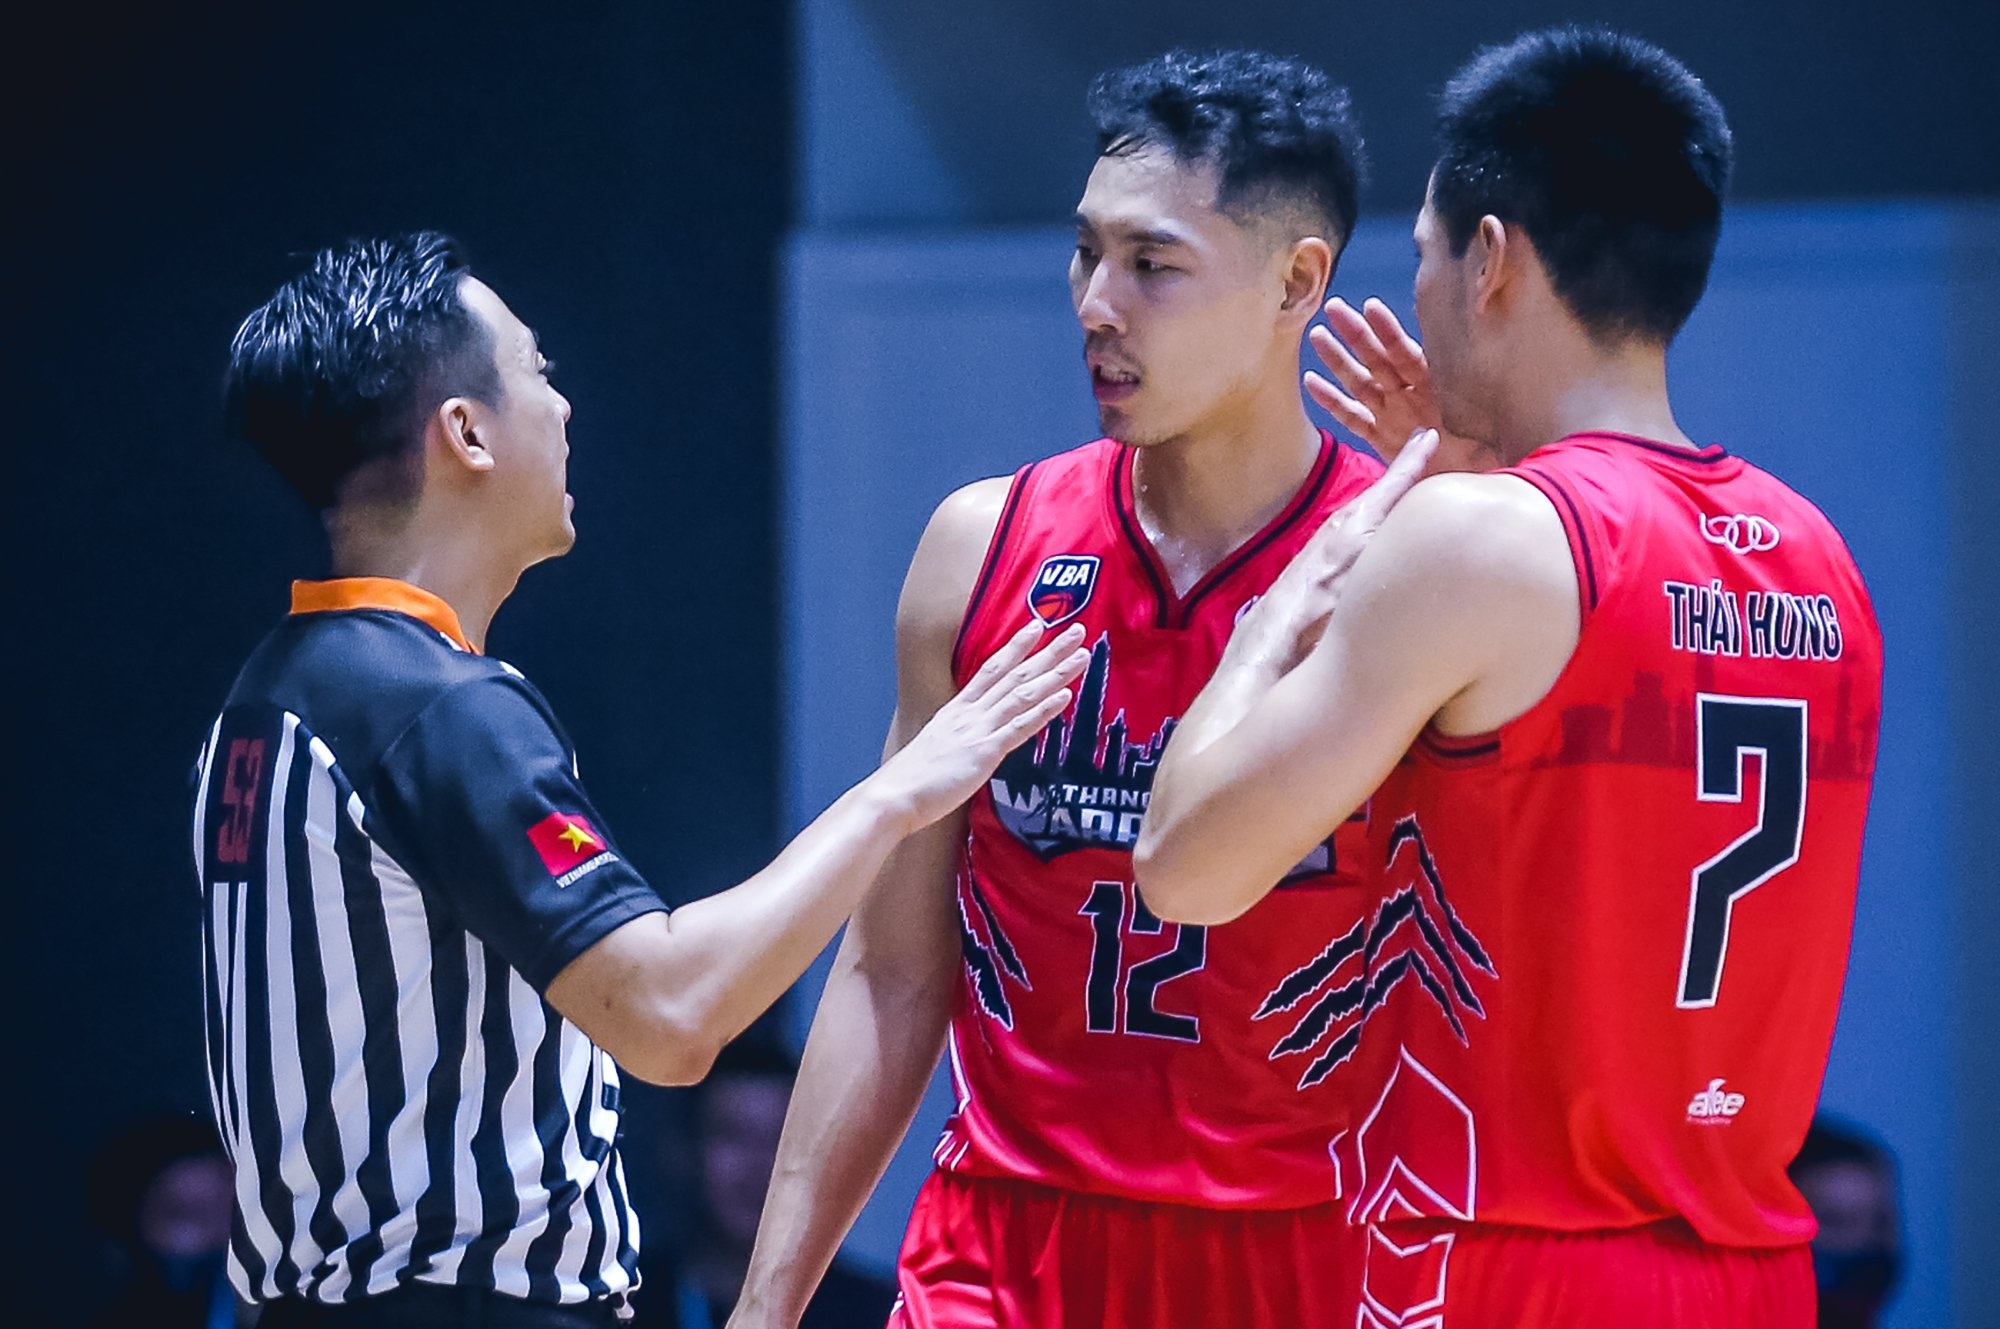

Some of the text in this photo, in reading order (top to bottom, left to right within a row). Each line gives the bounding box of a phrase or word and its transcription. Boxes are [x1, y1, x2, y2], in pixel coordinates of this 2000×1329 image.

[1042, 564, 1090, 586] VBA
[1664, 579, 1741, 656] THÁI
[1676, 692, 1808, 1008] 7
[1077, 880, 1207, 1043] 12
